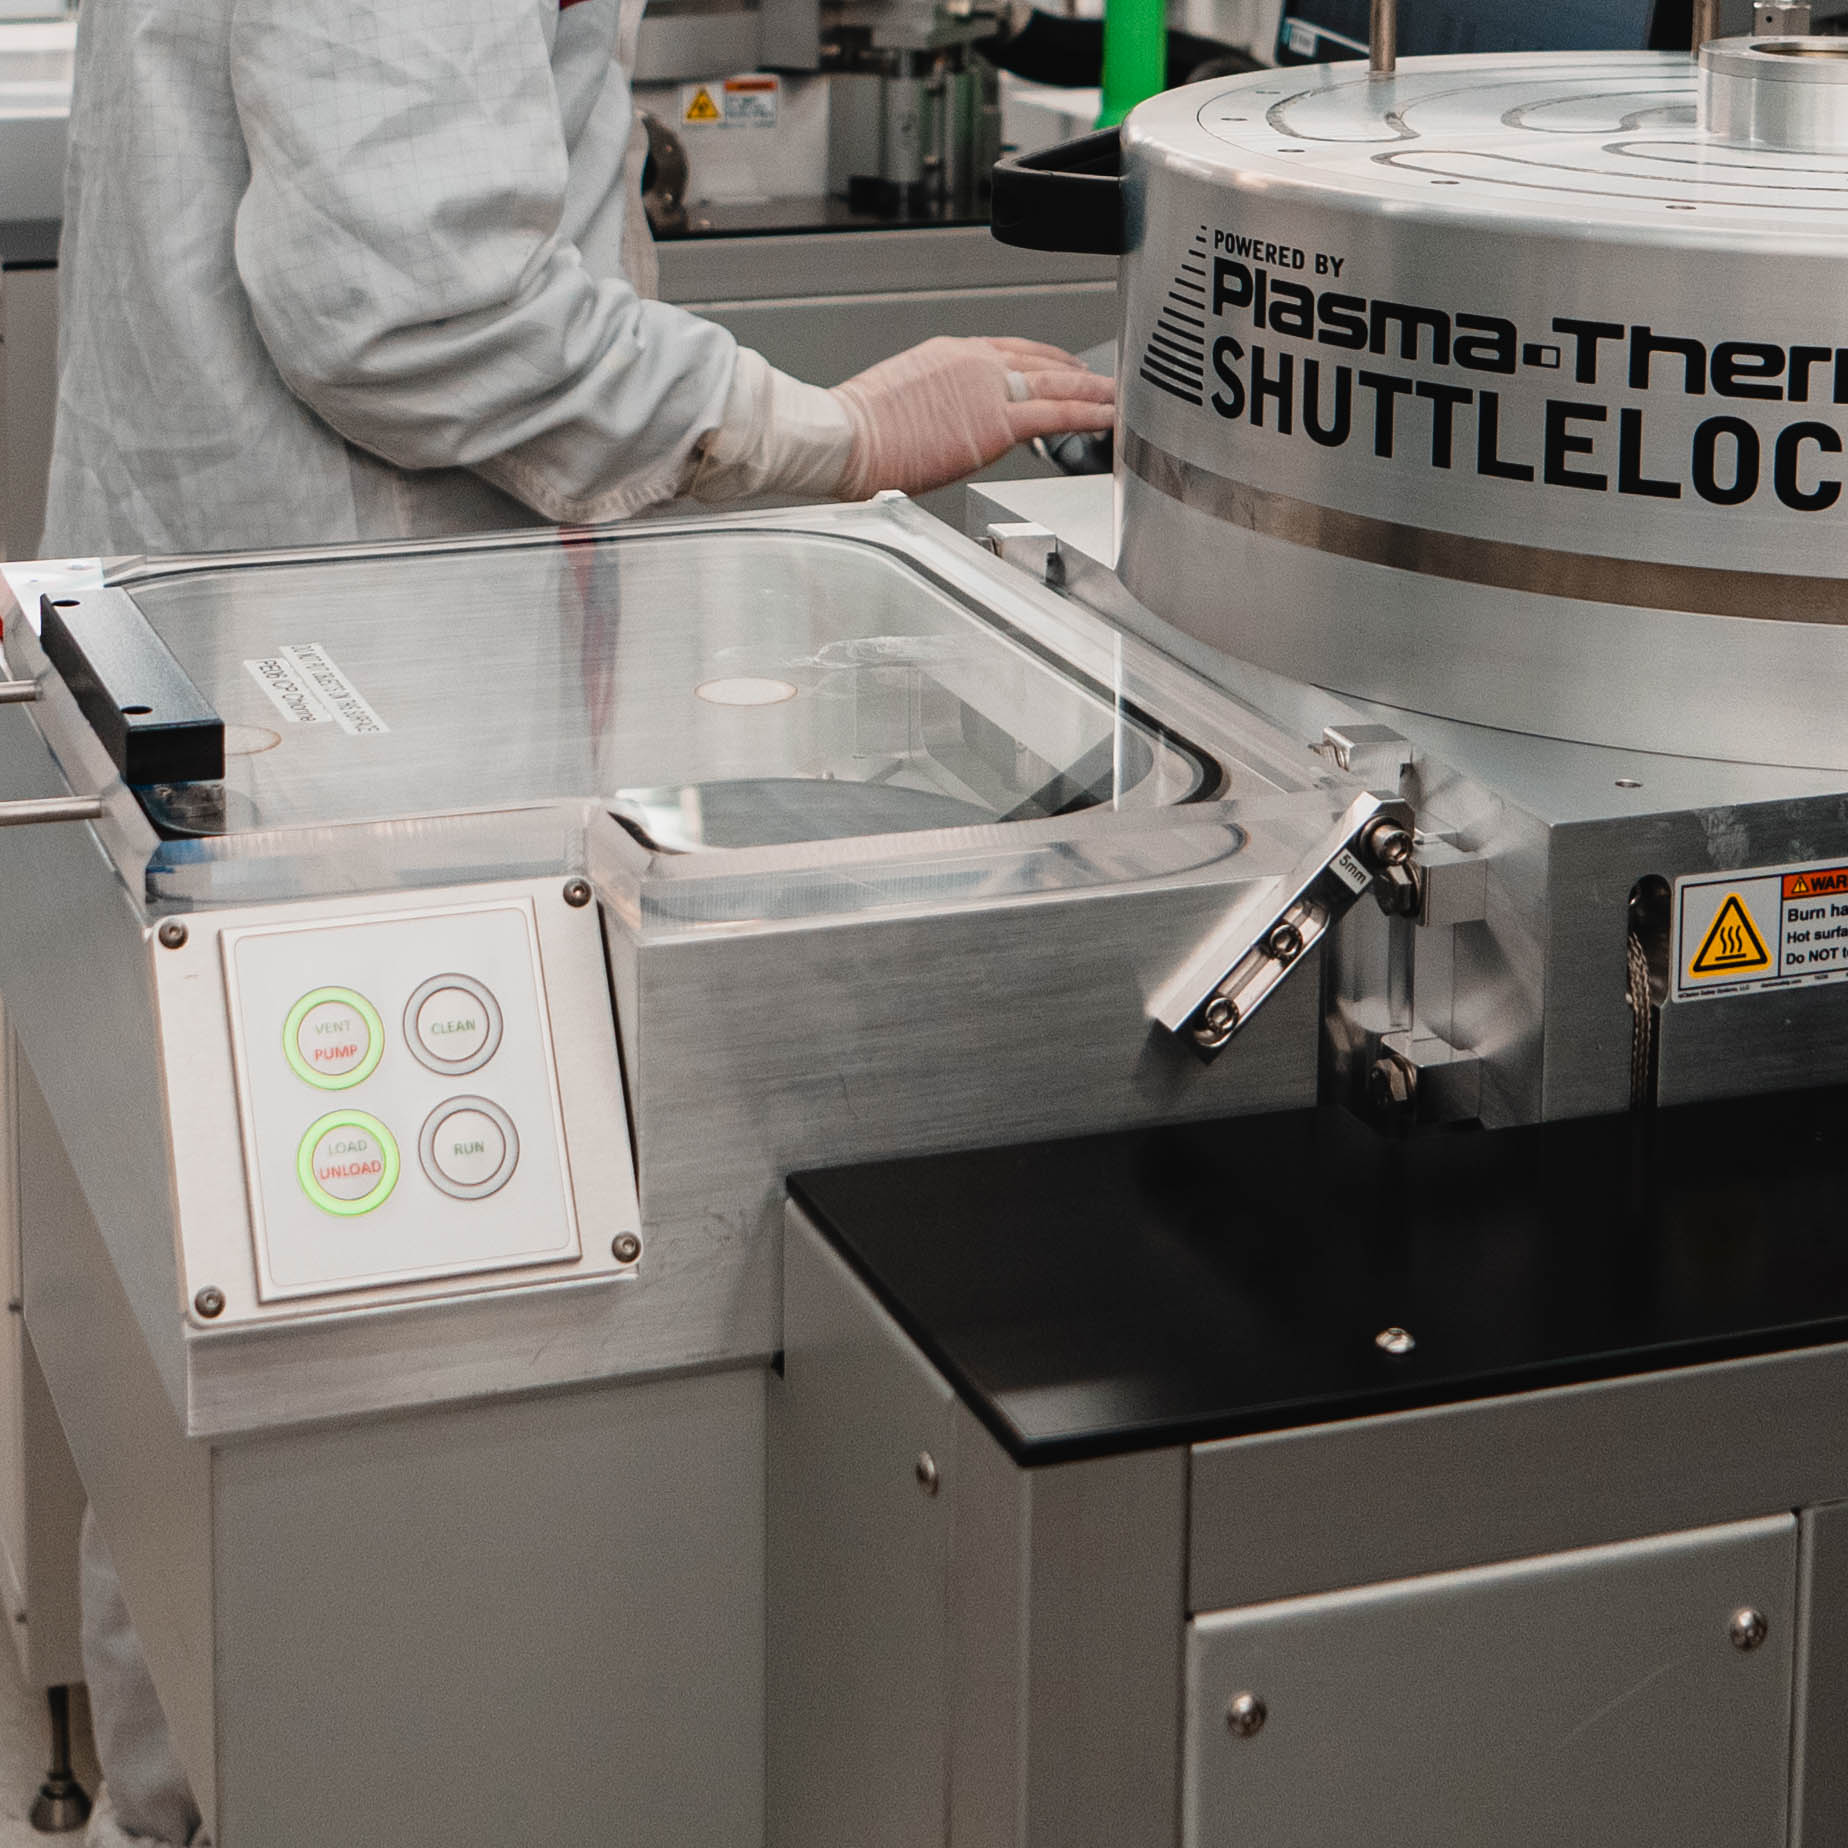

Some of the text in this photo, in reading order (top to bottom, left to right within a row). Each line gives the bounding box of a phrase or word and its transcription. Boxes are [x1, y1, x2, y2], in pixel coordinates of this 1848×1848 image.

[1213, 229, 1344, 278] POWERED BY
[1339, 854, 1366, 884] 5mm
[1787, 907, 1825, 923] Burn
[1787, 929, 1810, 944] Hot
[1786, 951, 1805, 965] Do
[1808, 948, 1838, 963] NOT
[314, 1020, 352, 1035] VENT
[431, 1019, 476, 1035] CLEAN
[314, 1045, 358, 1062] PUMP
[328, 1139, 367, 1156] LOAD
[453, 1141, 485, 1156] RUN
[319, 1160, 382, 1180] UNLOAD
